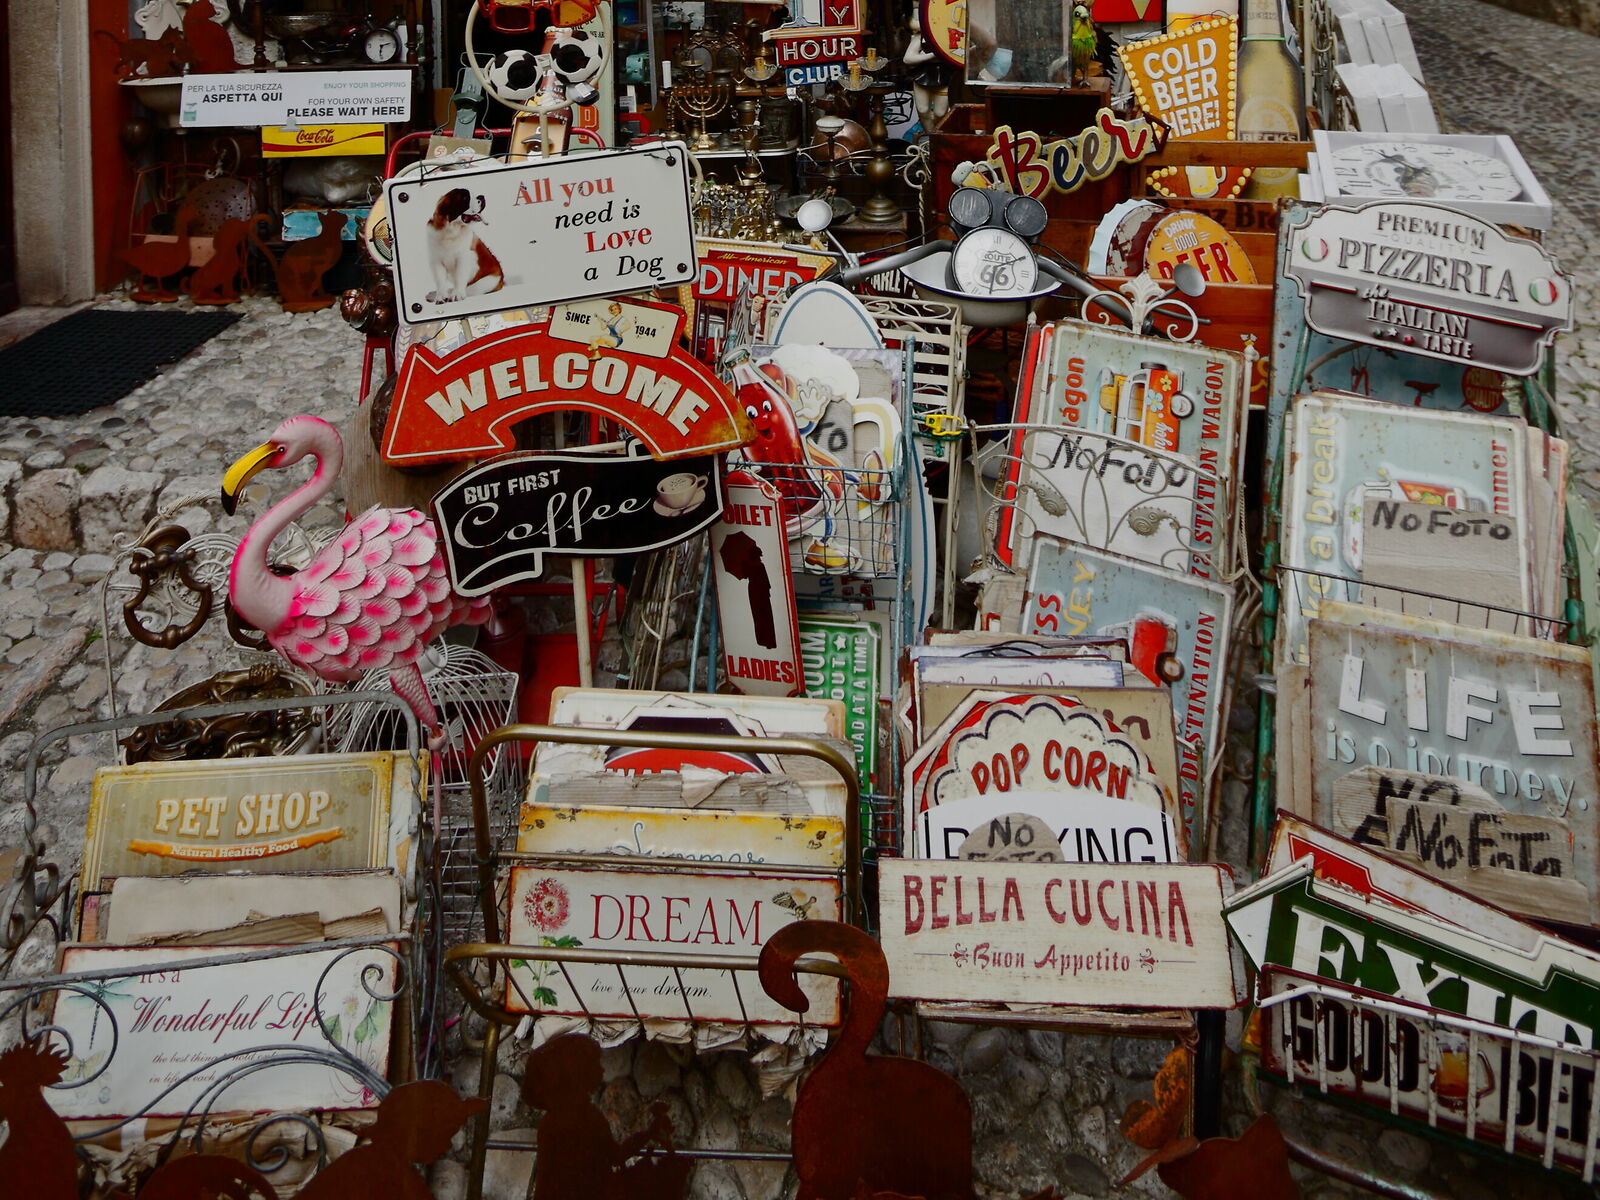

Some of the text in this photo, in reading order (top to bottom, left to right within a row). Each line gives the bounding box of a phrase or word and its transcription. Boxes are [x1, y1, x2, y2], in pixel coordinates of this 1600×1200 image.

[782, 37, 857, 62] HOUR
[1142, 37, 1218, 79] COLD
[187, 84, 203, 92] PER
[205, 84, 216, 92] LA
[218, 83, 234, 92] TUA
[236, 83, 282, 92] SICUREZZA
[789, 64, 844, 85] CLUB
[1151, 67, 1220, 112] BEER
[202, 92, 283, 104] ASPETTA QUI
[286, 105, 405, 118] PLEASE WAIT HERE
[372, 96, 406, 104] SAFETY
[1162, 99, 1221, 141] HERE!
[296, 129, 335, 144] Coca-Cola
[989, 108, 1149, 198] Beer
[513, 176, 613, 207] All you
[554, 198, 640, 229] need is
[1164, 218, 1197, 238] DRINK
[584, 226, 652, 254] Love
[1376, 211, 1488, 251] PREMIUM
[584, 254, 663, 281] a Dog
[980, 264, 1009, 286] 66
[1337, 237, 1519, 303] PIZZERIA
[1360, 283, 1389, 301] the
[565, 311, 656, 338] SINCE 1944
[1366, 299, 1469, 339] ITALIAN
[1422, 332, 1474, 360] TASTE
[424, 351, 710, 437] WELCOME
[1051, 435, 1096, 471] No
[1193, 360, 1225, 546] STATION WAGON
[1306, 411, 1337, 524] break
[463, 469, 561, 504] BUT FIRST
[454, 486, 656, 550] Coffee
[1373, 501, 1422, 532] No
[1310, 535, 1332, 560] a
[727, 655, 795, 684] LADIES
[854, 634, 868, 674] TIME
[1338, 654, 1575, 757] LIFE
[1327, 719, 1356, 764] is
[971, 740, 1132, 800] POP CORN
[155, 790, 330, 837] PET SHOP
[170, 840, 299, 858] Natural Healthy Food
[589, 894, 764, 946] DREAM
[903, 874, 1194, 947] BELLA CUCINA
[971, 942, 1130, 976] Buon Appetito
[591, 977, 613, 993] live
[619, 986, 647, 1000] your
[129, 992, 328, 1043] Wonderful Life
[1281, 982, 1420, 1093] GOOD
[152, 1052, 188, 1063] the best
[149, 1075, 160, 1083] in
[192, 1071, 215, 1083] each
